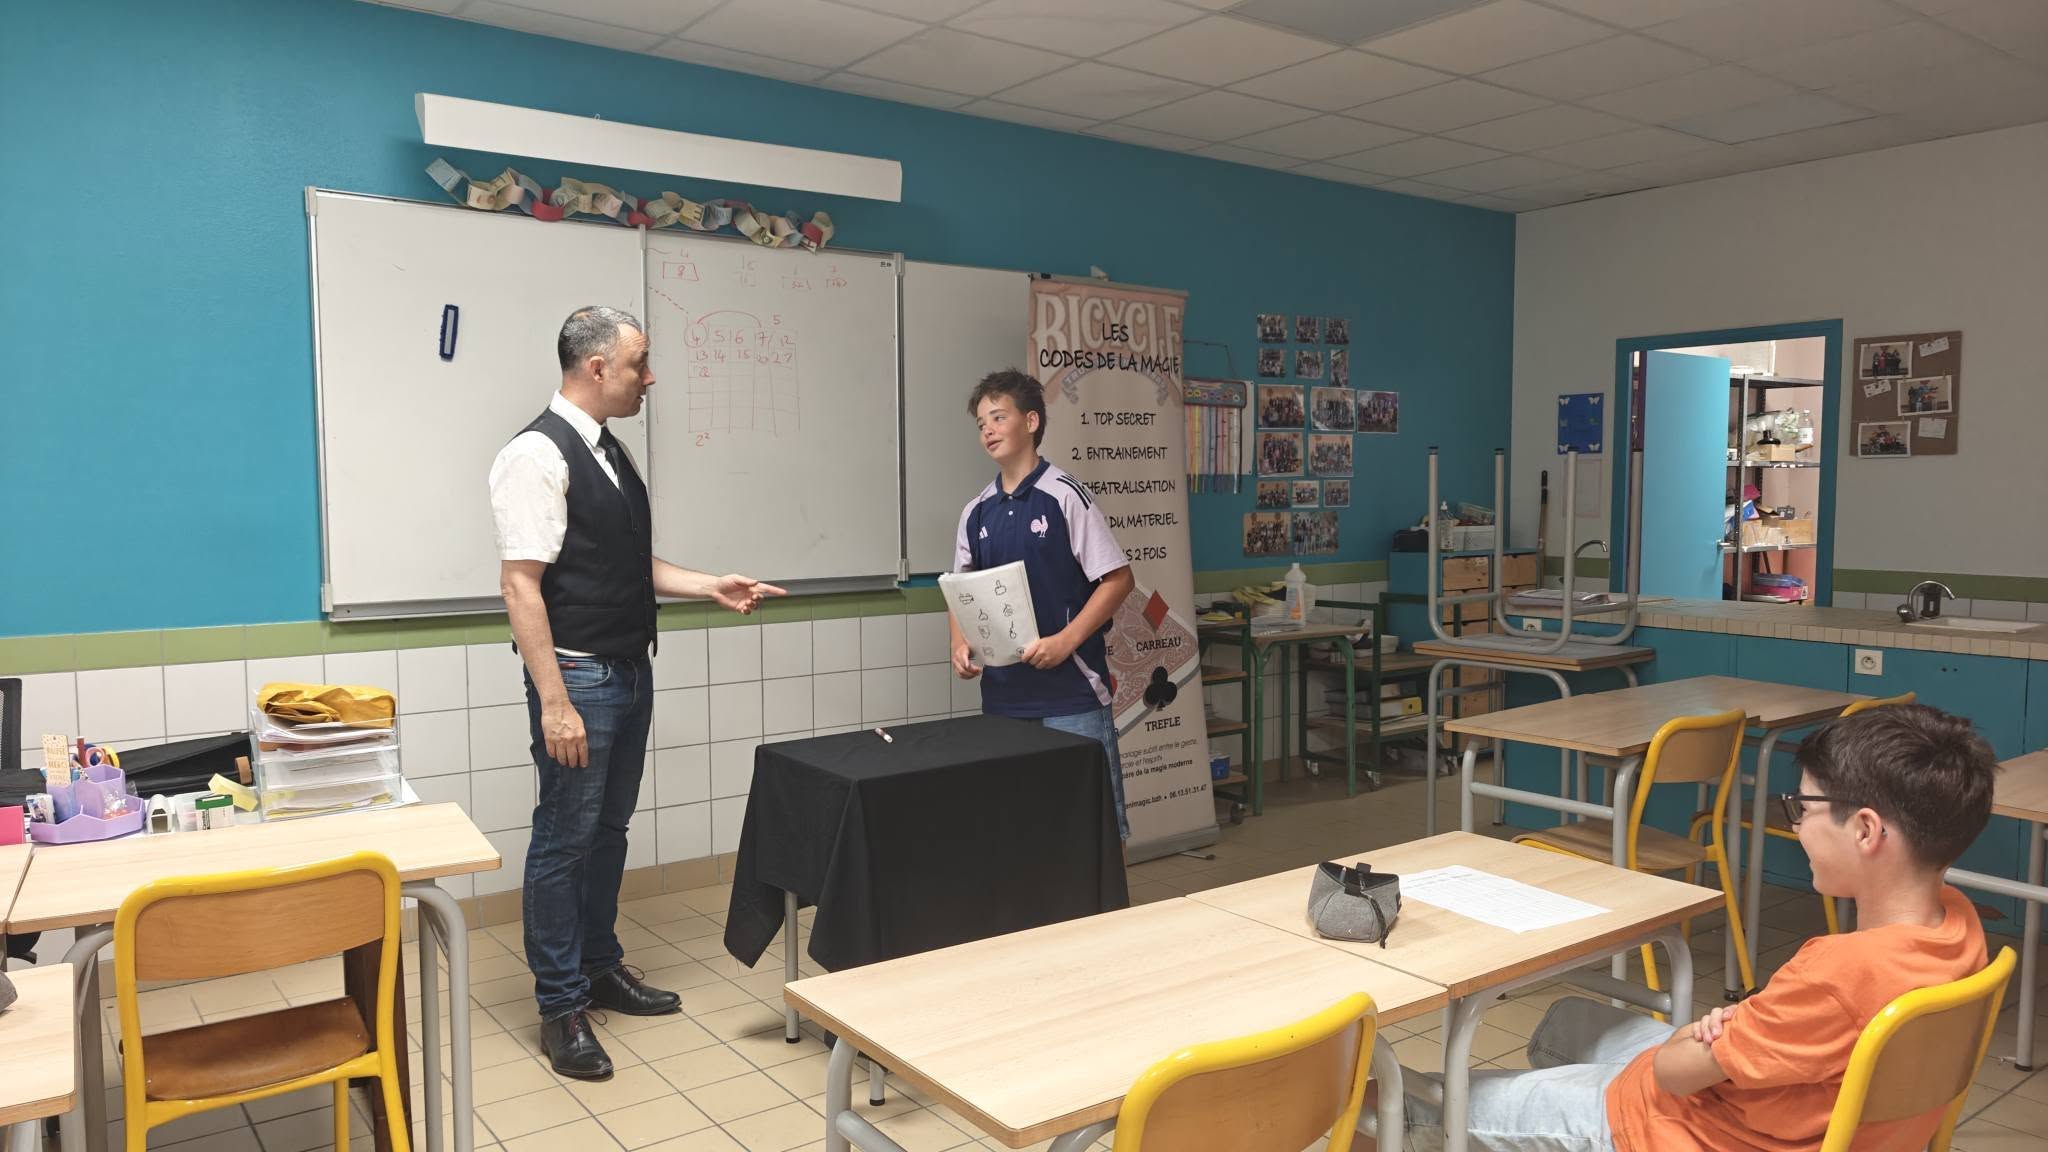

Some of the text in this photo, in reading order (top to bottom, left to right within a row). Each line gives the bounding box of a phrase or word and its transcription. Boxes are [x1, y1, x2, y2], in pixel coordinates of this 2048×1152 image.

[1032, 292, 1181, 380] BICYCLE
[1102, 322, 1129, 342] LES
[1039, 348, 1181, 374] CODES DE LA MAGIE
[1081, 411, 1157, 426] 1. TOP SECRET
[1071, 446, 1168, 460] 2. ENTRAINEMENT
[1109, 515, 1125, 528] DU
[1127, 512, 1179, 528] MATERIEL
[1134, 548, 1142, 560] 2
[1143, 547, 1167, 560] FOIS
[1136, 636, 1182, 652] CARREAU
[1145, 716, 1181, 732] TREFLE
[1151, 765, 1167, 773] magie
[1168, 759, 1193, 768] moderne
